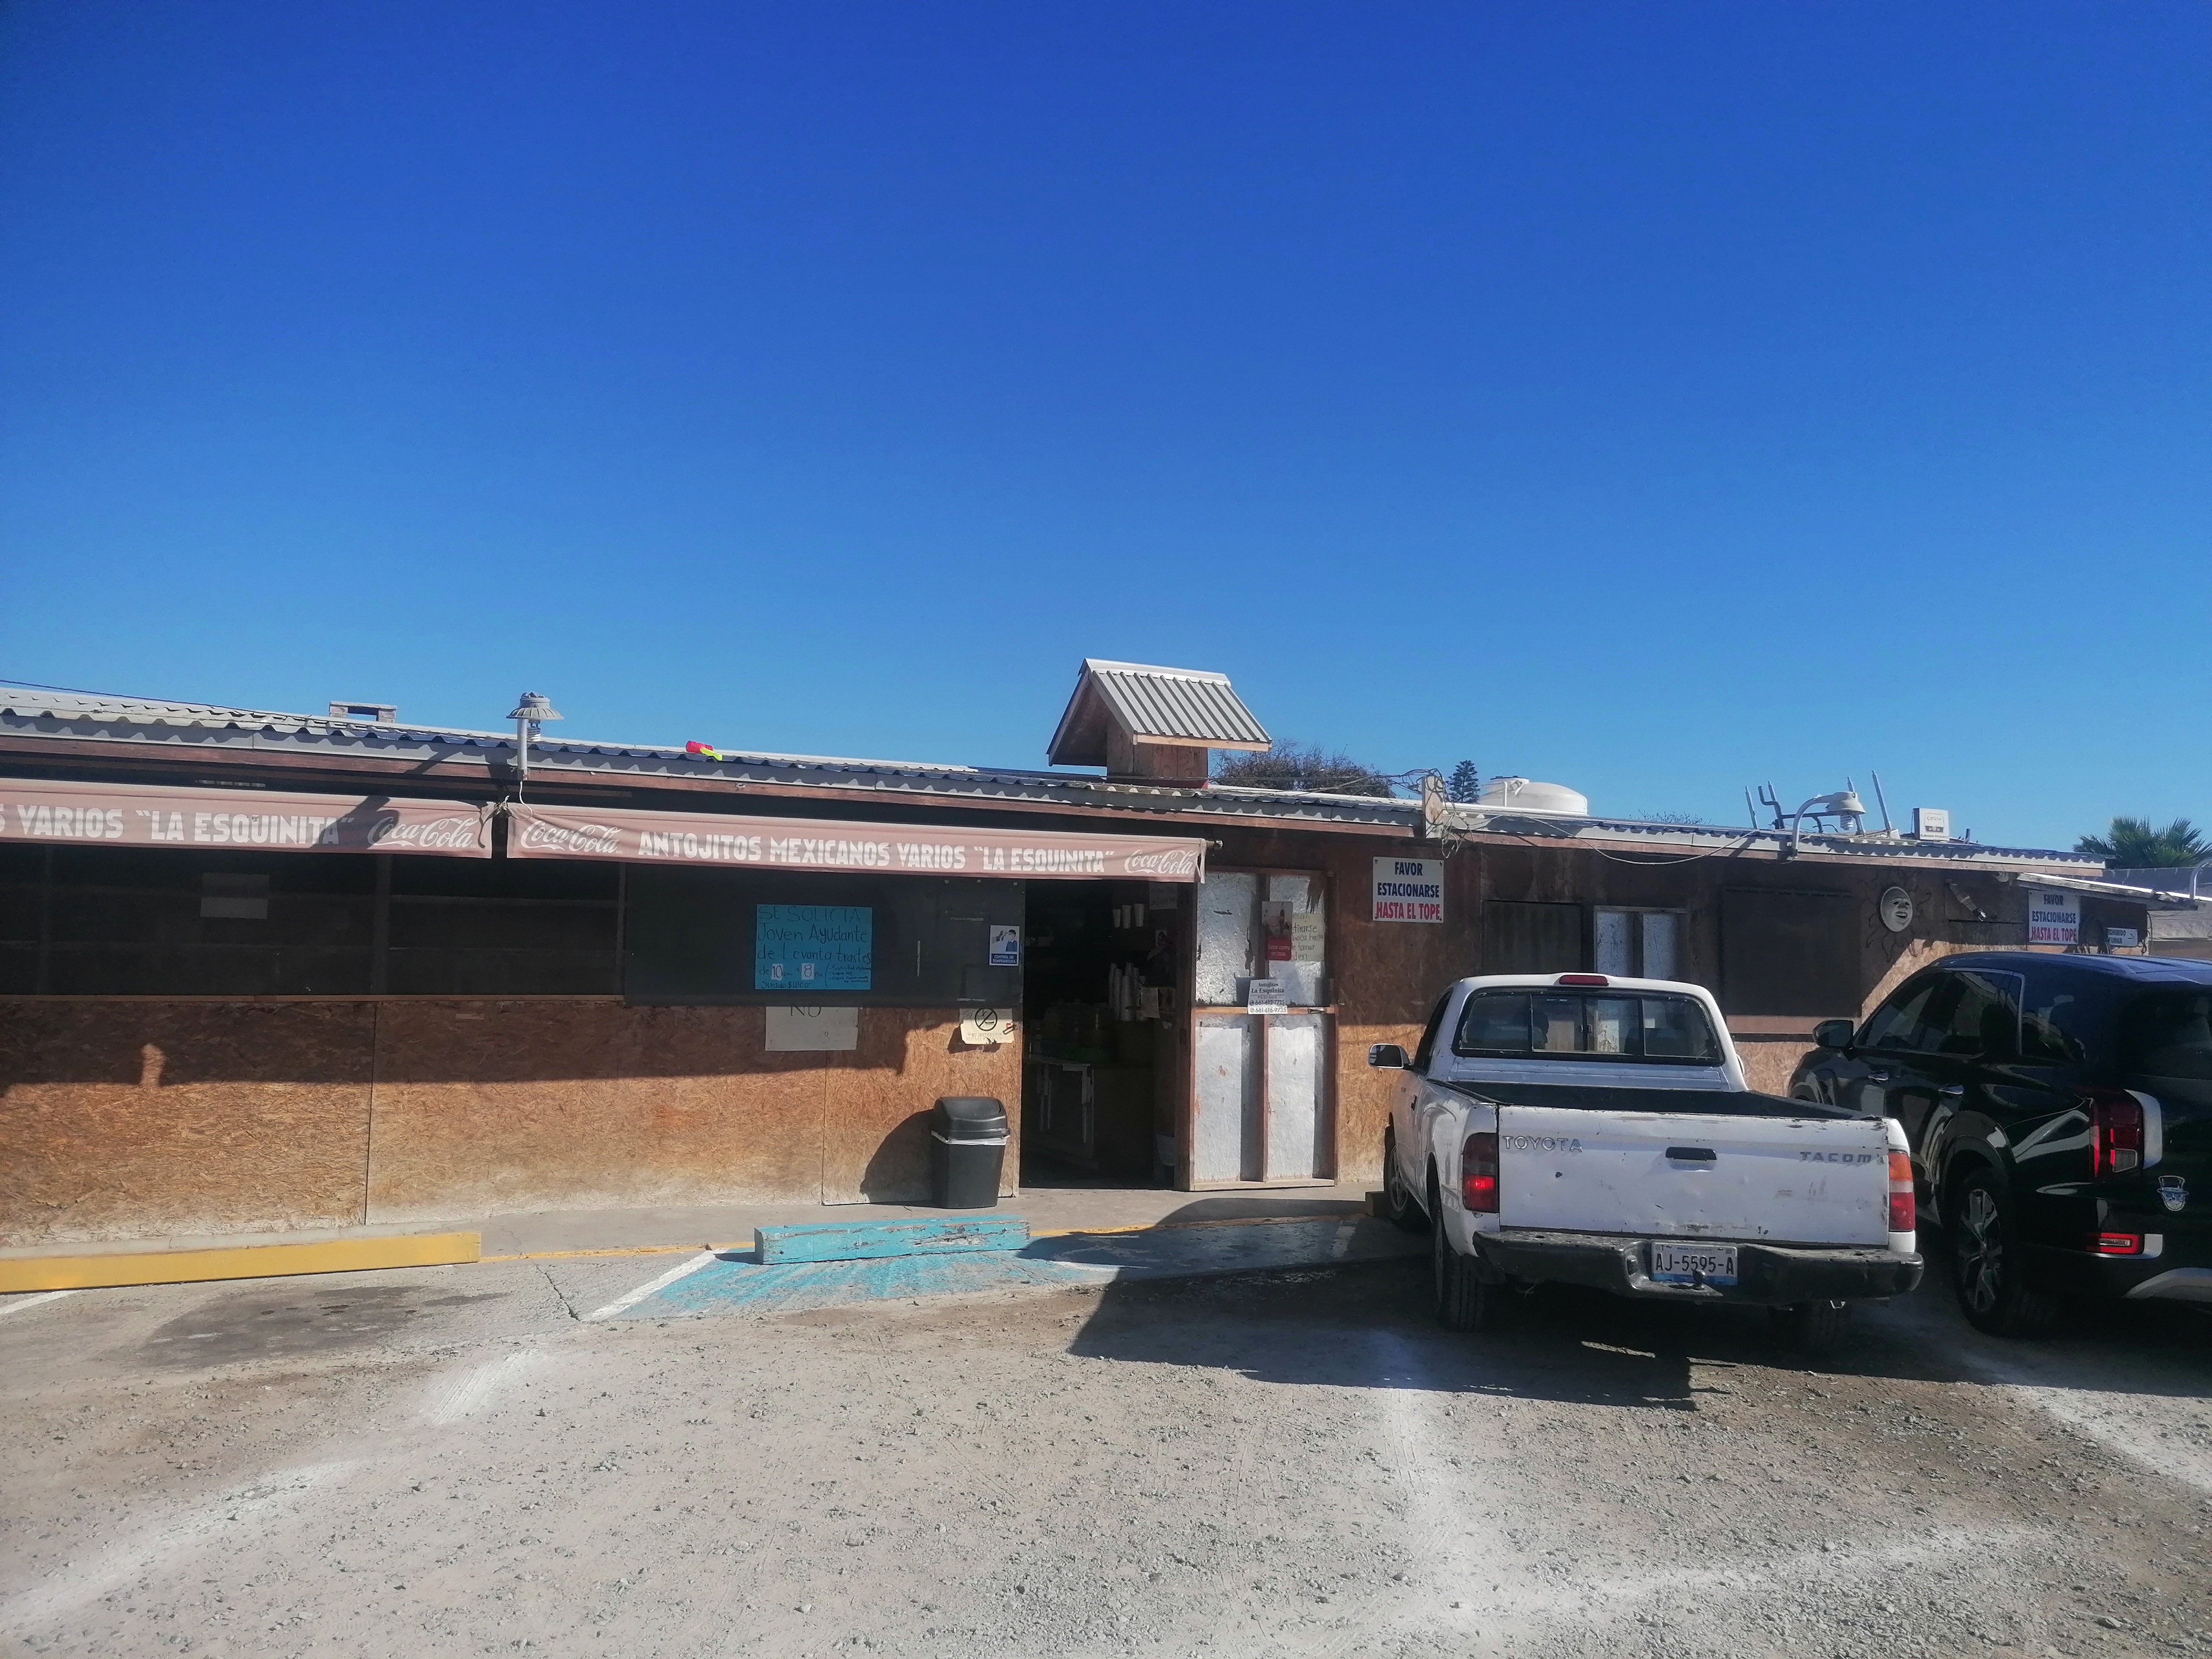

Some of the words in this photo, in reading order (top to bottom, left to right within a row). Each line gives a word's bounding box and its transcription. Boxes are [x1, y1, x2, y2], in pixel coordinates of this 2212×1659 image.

[17, 805, 124, 838] VARIOS
[367, 816, 479, 848] Coca-Cola
[521, 820, 623, 854] Coca-Cola
[638, 831, 762, 861] ANTOJITOS
[769, 836, 890, 867] MEXICANOS
[896, 842, 966, 869] VARIOS
[1124, 849, 1198, 875] Coca-Cola
[1395, 862, 1423, 876] FAVOR
[1377, 882, 1439, 898] ESTACIONARSE
[2043, 894, 2064, 906] FAVOR
[758, 905, 780, 920] SE
[1376, 901, 1405, 919] HASTA
[1407, 902, 1416, 919] EL
[1418, 903, 1440, 920] TOPE
[2032, 910, 2076, 924] ESTACIONARSE
[2031, 926, 2051, 941] HASTA
[2053, 927, 2059, 941] EL
[2060, 928, 2077, 942] TOPE
[758, 944, 775, 960] de
[836, 943, 872, 964] trastes
[759, 965, 769, 975] de
[1502, 1135, 1583, 1152] TOYOTA
[1656, 1253, 1734, 1275] AJ-5595-A
